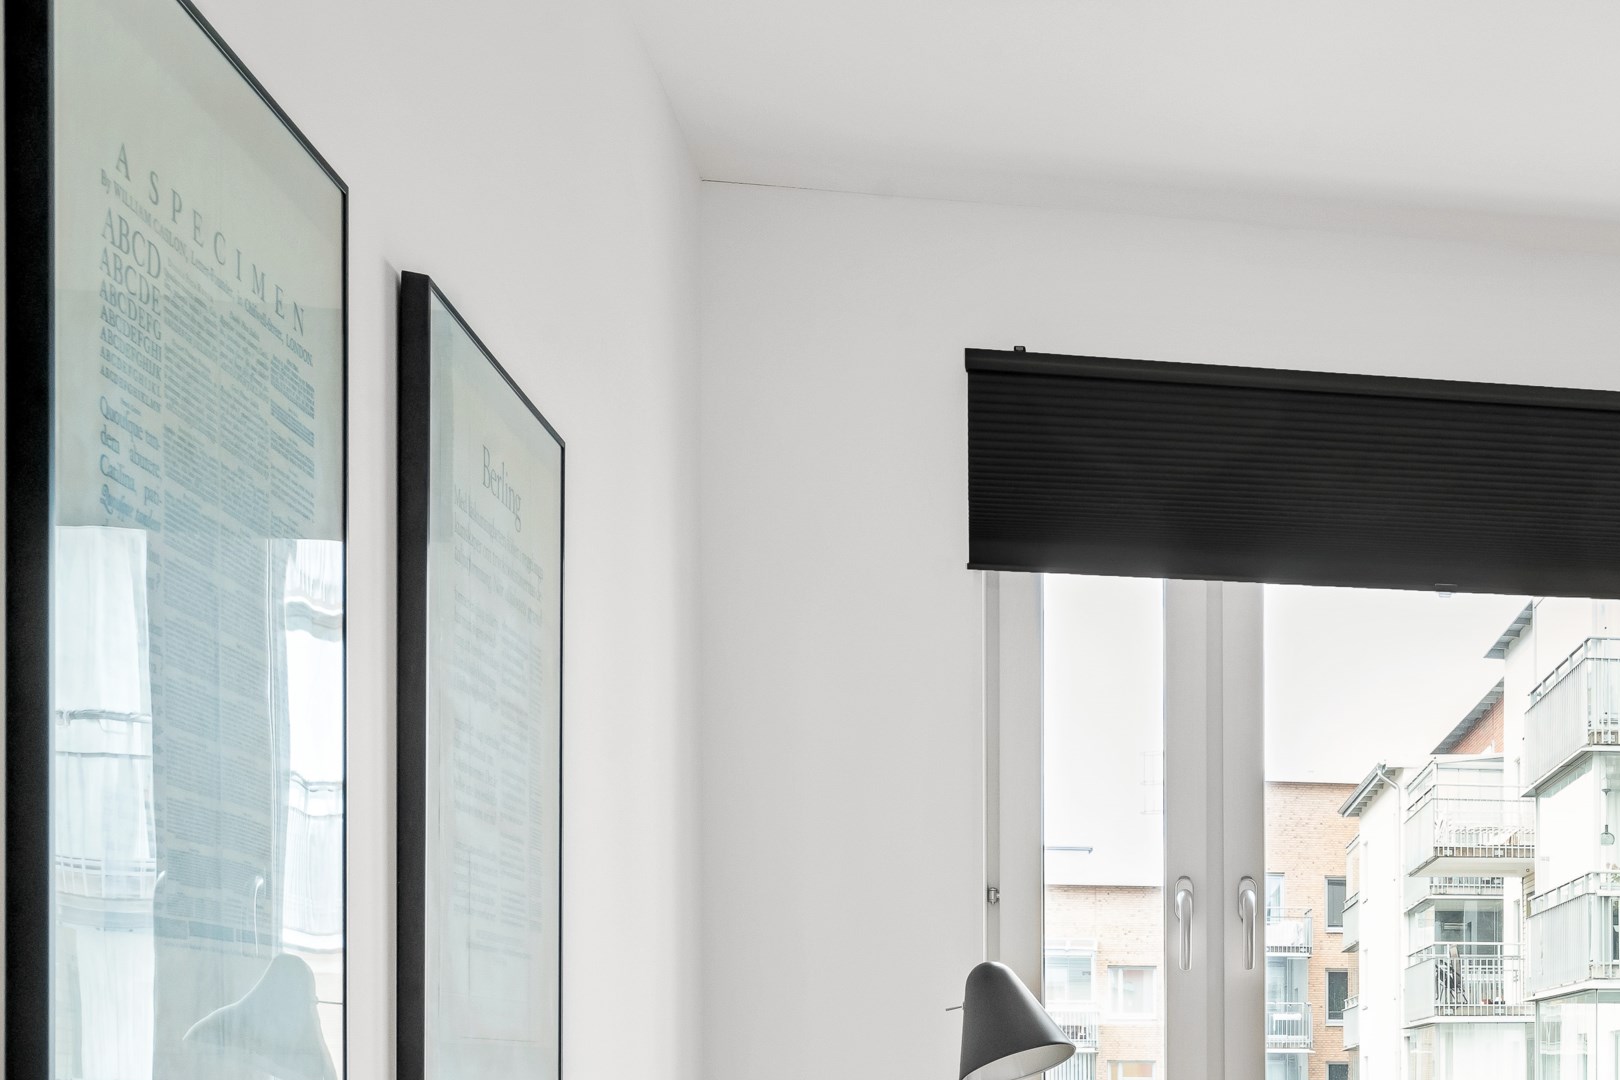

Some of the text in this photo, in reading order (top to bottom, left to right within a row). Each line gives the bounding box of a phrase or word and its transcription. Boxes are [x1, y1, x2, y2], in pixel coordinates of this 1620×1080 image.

[101, 168, 111, 194] By
[101, 207, 161, 279] ABCD
[116, 142, 304, 337] A SPECIMEN
[100, 247, 161, 316] ABCDE
[100, 279, 162, 341] ABCDEFG
[482, 444, 522, 533] Berling
